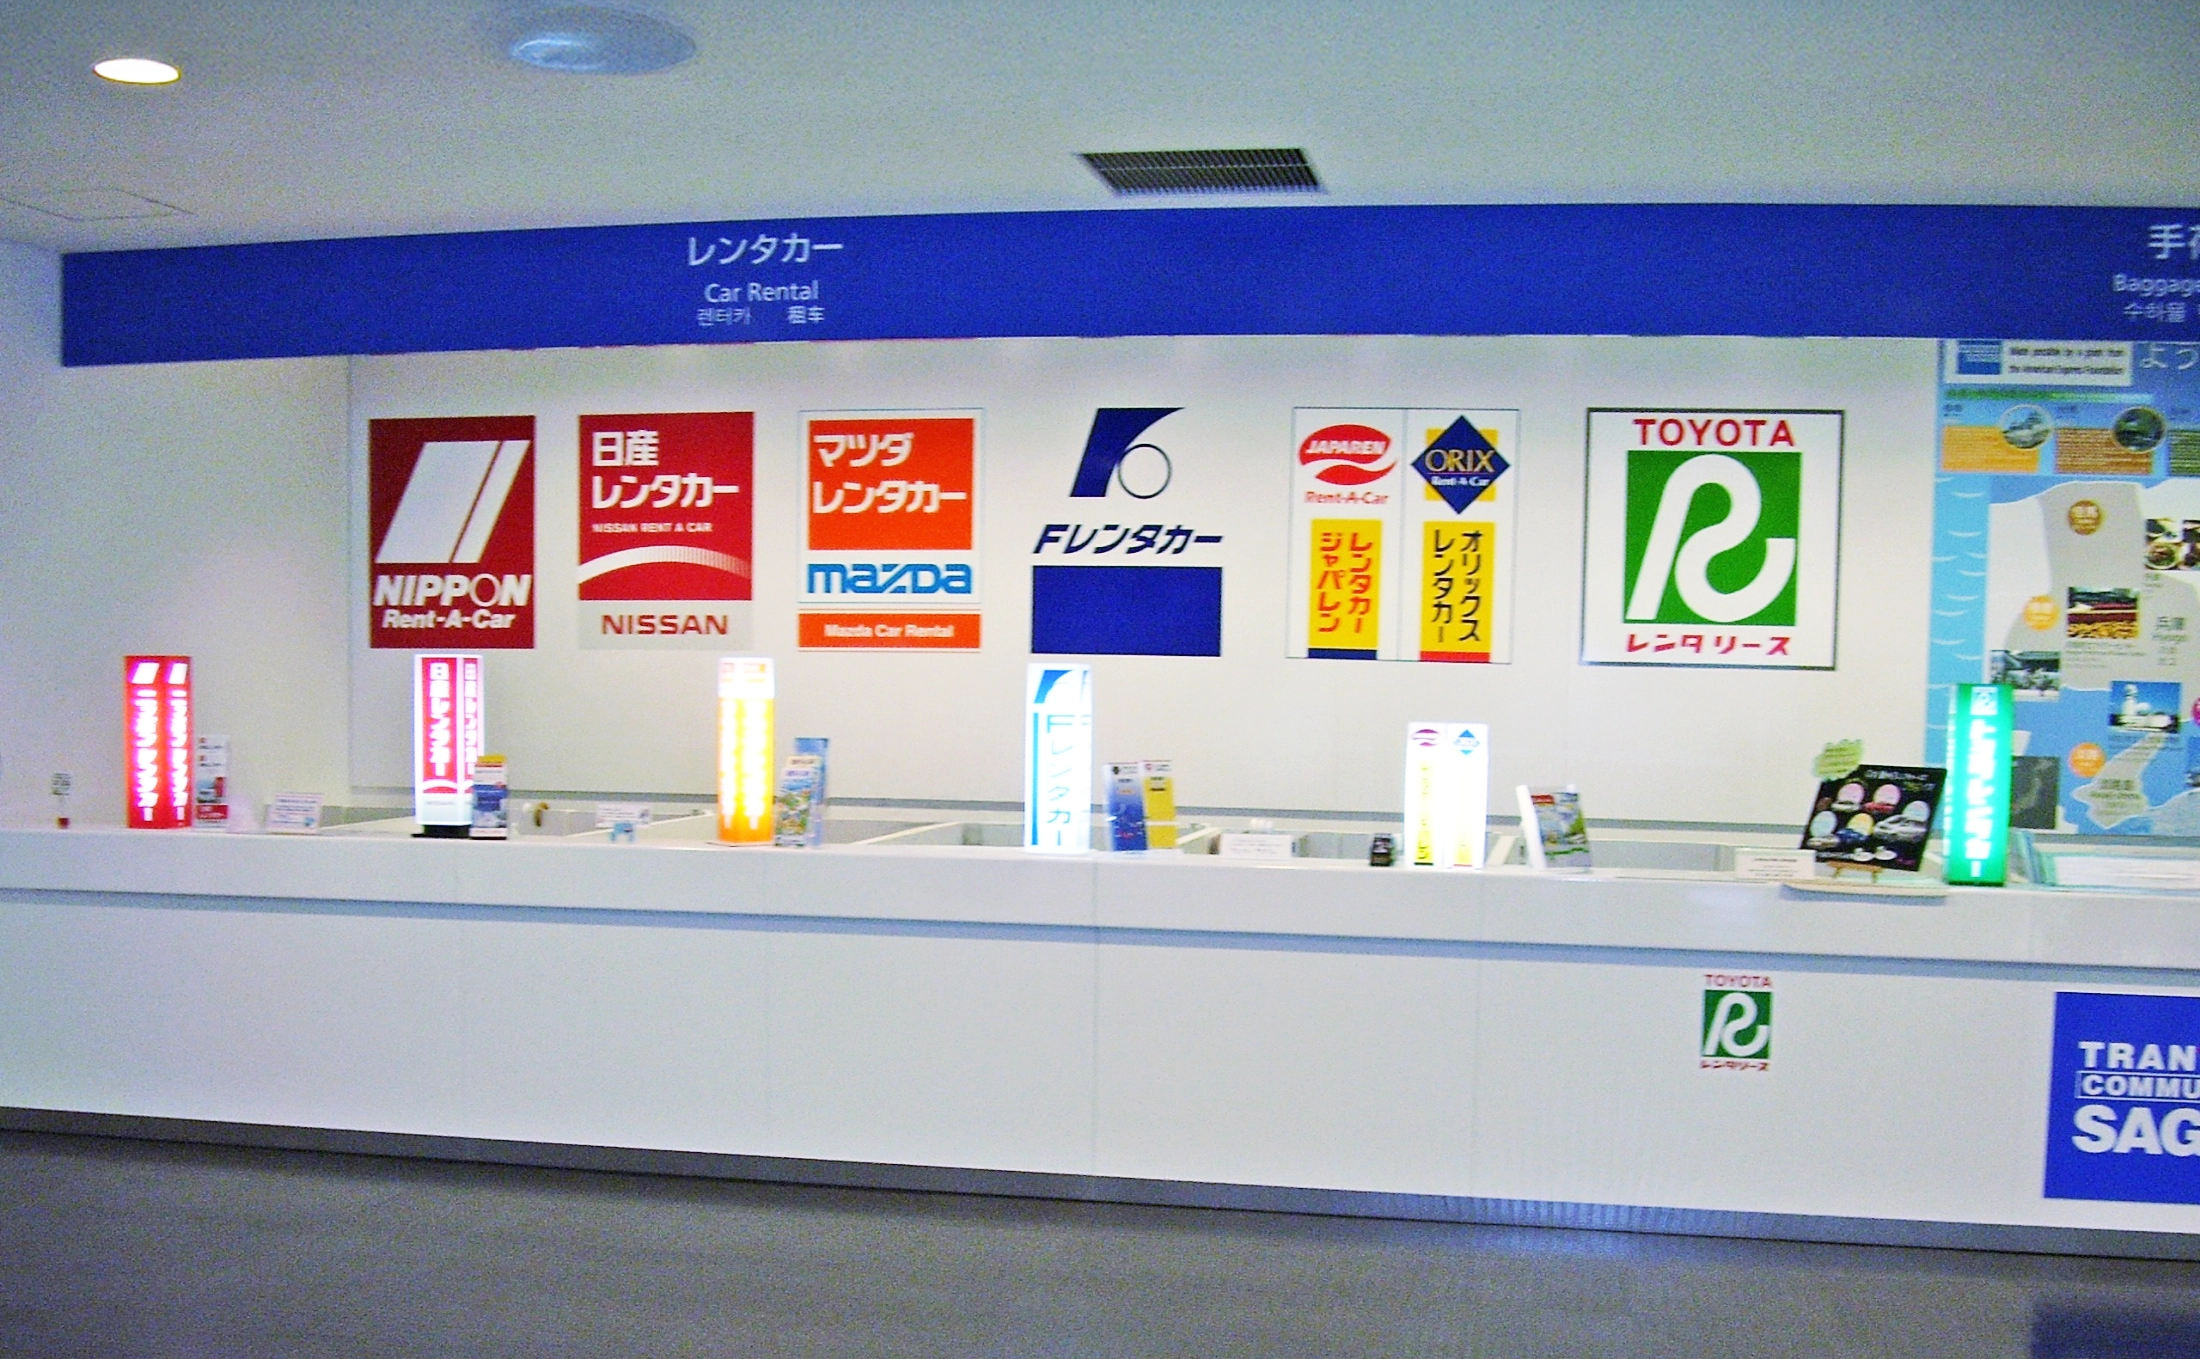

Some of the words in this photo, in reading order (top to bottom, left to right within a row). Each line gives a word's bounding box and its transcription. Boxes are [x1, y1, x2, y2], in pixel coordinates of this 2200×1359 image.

[687, 233, 843, 266] レンタカー
[704, 283, 741, 302] Car
[748, 280, 819, 301] Rental
[592, 430, 659, 466] 日産
[1633, 418, 1795, 447] TOYOTA
[813, 432, 915, 467] マツダ
[1424, 449, 1495, 472] ORIX
[592, 473, 739, 509] レンタカー
[813, 480, 967, 514] レンタカー
[1304, 490, 1390, 504] Rent-A-Car
[592, 523, 638, 533] NISSAN
[640, 522, 672, 533] RENT
[686, 522, 713, 533] CAR
[1032, 523, 1224, 554] Fレンタカー
[372, 573, 532, 607] NIPPON
[1317, 532, 1344, 633] ジャパレン
[1349, 532, 1373, 633] レンタカー
[1432, 529, 1455, 642] レンタカー
[1459, 531, 1483, 642] オリックス
[382, 609, 517, 629] Rent-A-Car
[602, 614, 728, 635] NISSAN
[824, 624, 873, 637] Mazda
[875, 624, 902, 637] Car
[905, 624, 955, 638] Rental
[1626, 633, 1791, 656] レンタリース
[1704, 974, 1774, 989] TOYOTA
